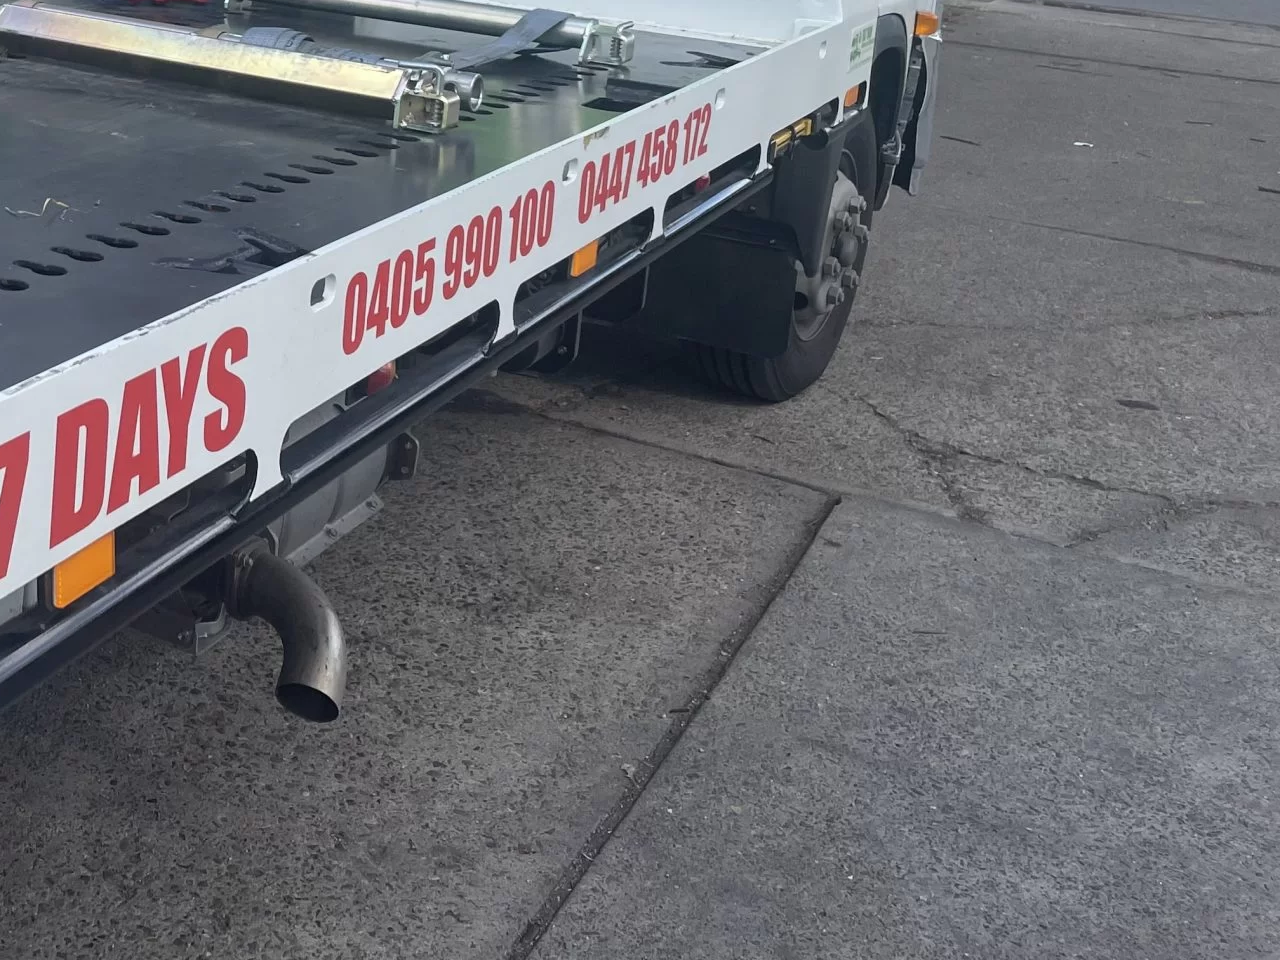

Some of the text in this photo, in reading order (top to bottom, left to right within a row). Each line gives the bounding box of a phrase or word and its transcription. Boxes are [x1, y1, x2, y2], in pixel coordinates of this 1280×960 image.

[49, 326, 248, 549] DAYS
[343, 237, 436, 355] 0405
[443, 205, 503, 299] 990
[509, 180, 554, 263] 100
[578, 145, 636, 224] 0447
[637, 119, 678, 187] 458
[683, 103, 712, 167] 172
